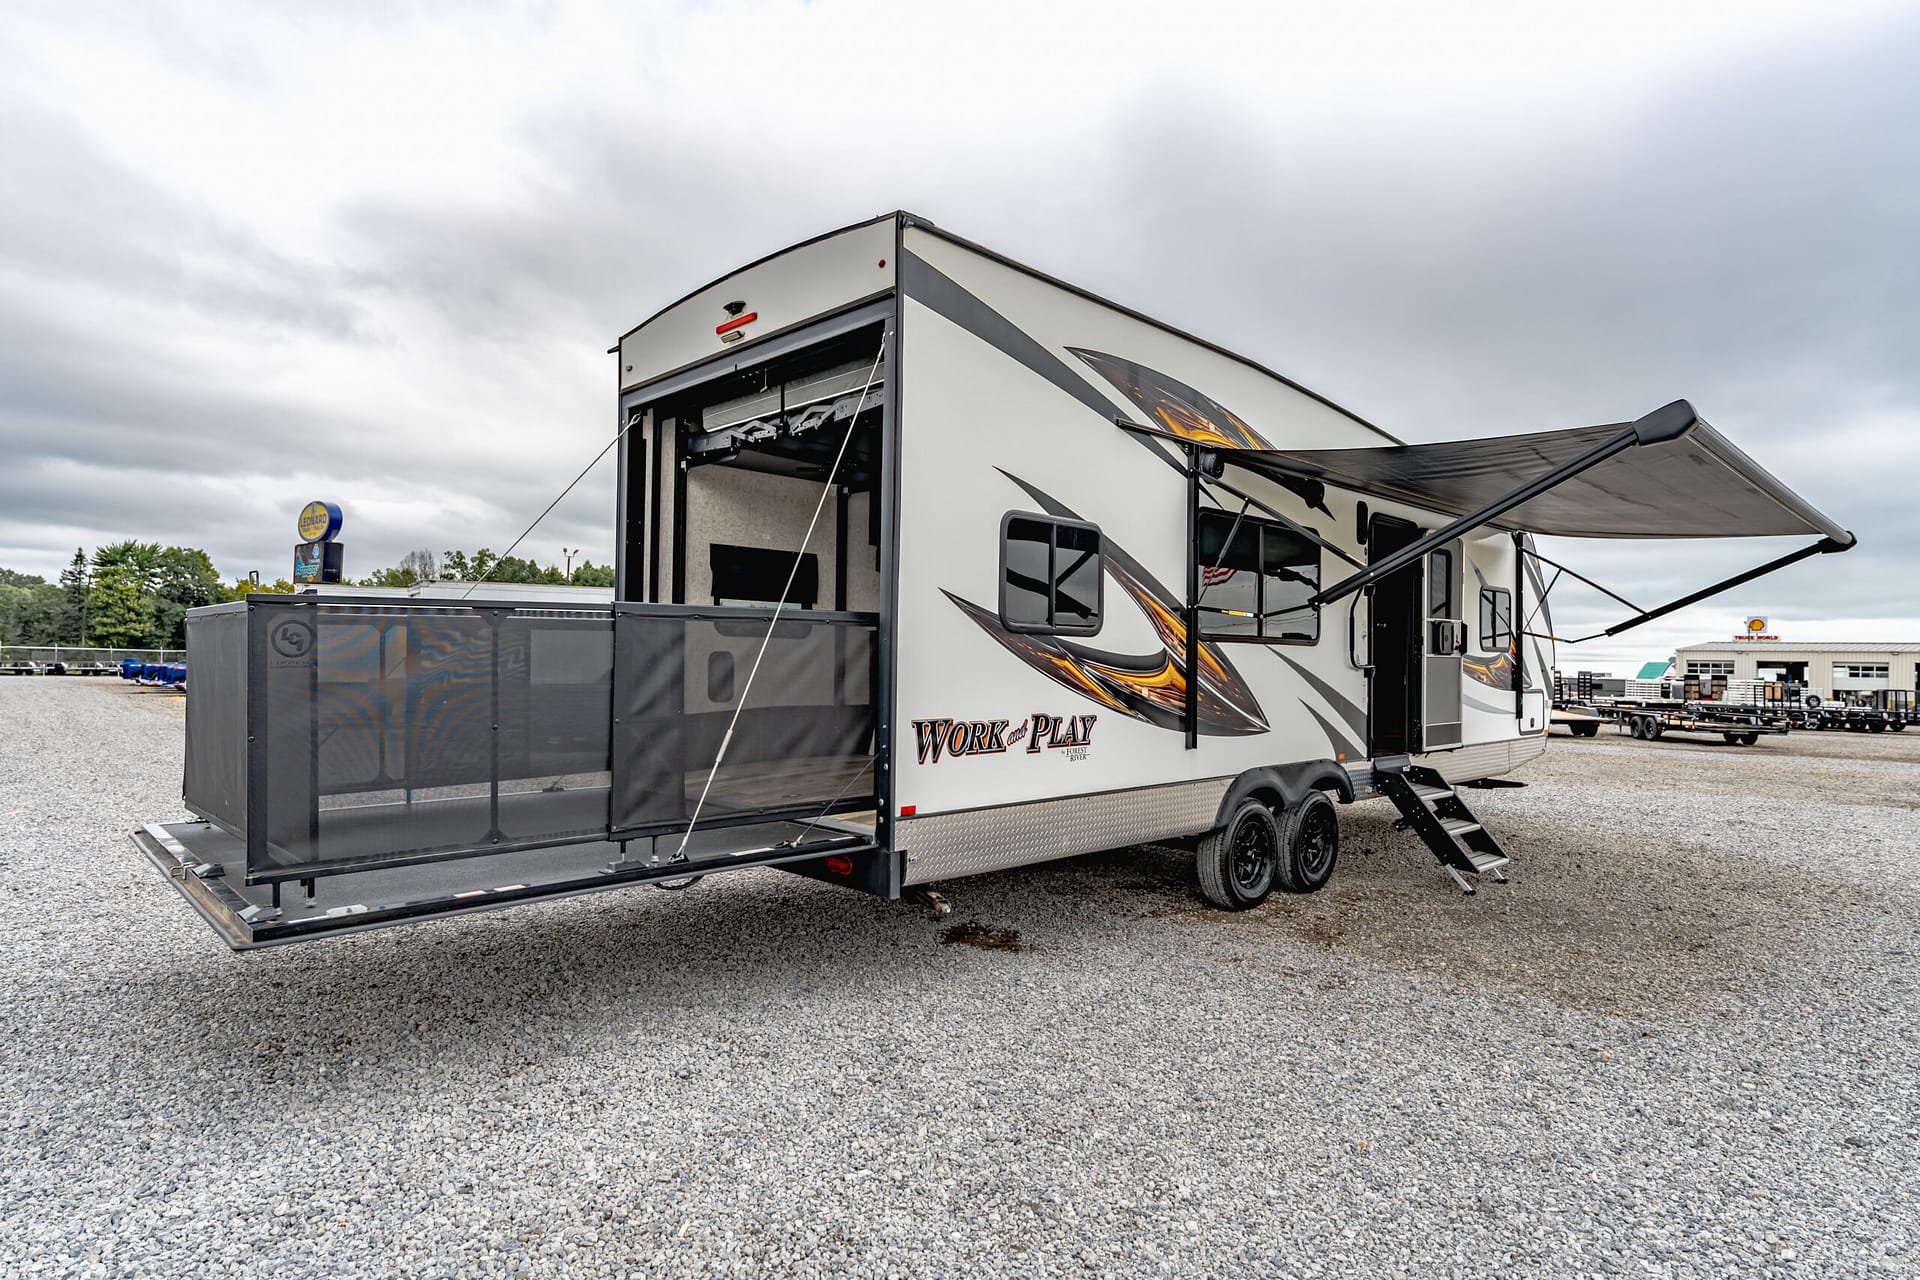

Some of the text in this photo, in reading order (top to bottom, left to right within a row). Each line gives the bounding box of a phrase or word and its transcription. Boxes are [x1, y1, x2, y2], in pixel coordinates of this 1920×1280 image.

[301, 514, 327, 528] LEONARD
[912, 713, 1097, 765] WORK and PLAY
[1066, 747, 1087, 755] FOREST
[1070, 754, 1087, 762] RIVER
